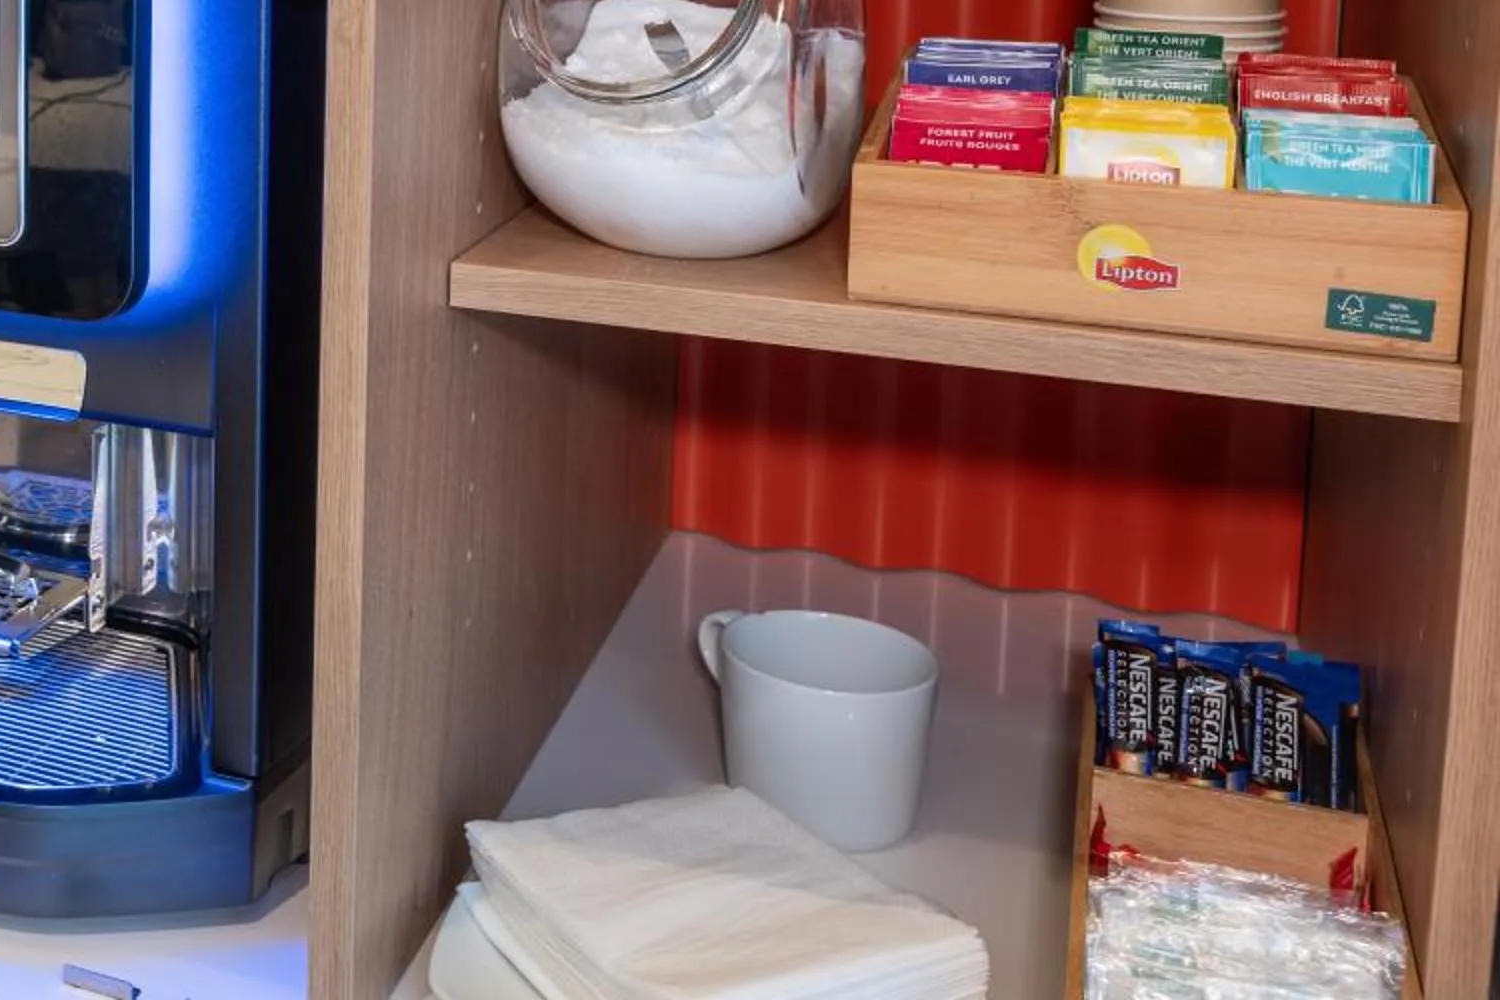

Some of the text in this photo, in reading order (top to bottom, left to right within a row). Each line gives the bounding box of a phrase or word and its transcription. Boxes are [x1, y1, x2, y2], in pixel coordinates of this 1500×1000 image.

[1138, 35, 1159, 45] TEA
[1161, 36, 1207, 47] ORIENT
[1123, 47, 1153, 58] VERT
[947, 73, 1012, 86] EARL GREY
[1137, 78, 1159, 89] TEA
[1162, 80, 1210, 92] ORIENT
[1253, 88, 1391, 107] ENGLISH BREAKFAST
[927, 127, 1016, 141] FOREST FRUIT
[919, 137, 1021, 151] FRUITS ROUGES
[1112, 164, 1175, 185] Lipton
[1101, 258, 1174, 285] Lipton
[1116, 650, 1127, 741] SELECTION
[1261, 687, 1275, 779] SELECTION
